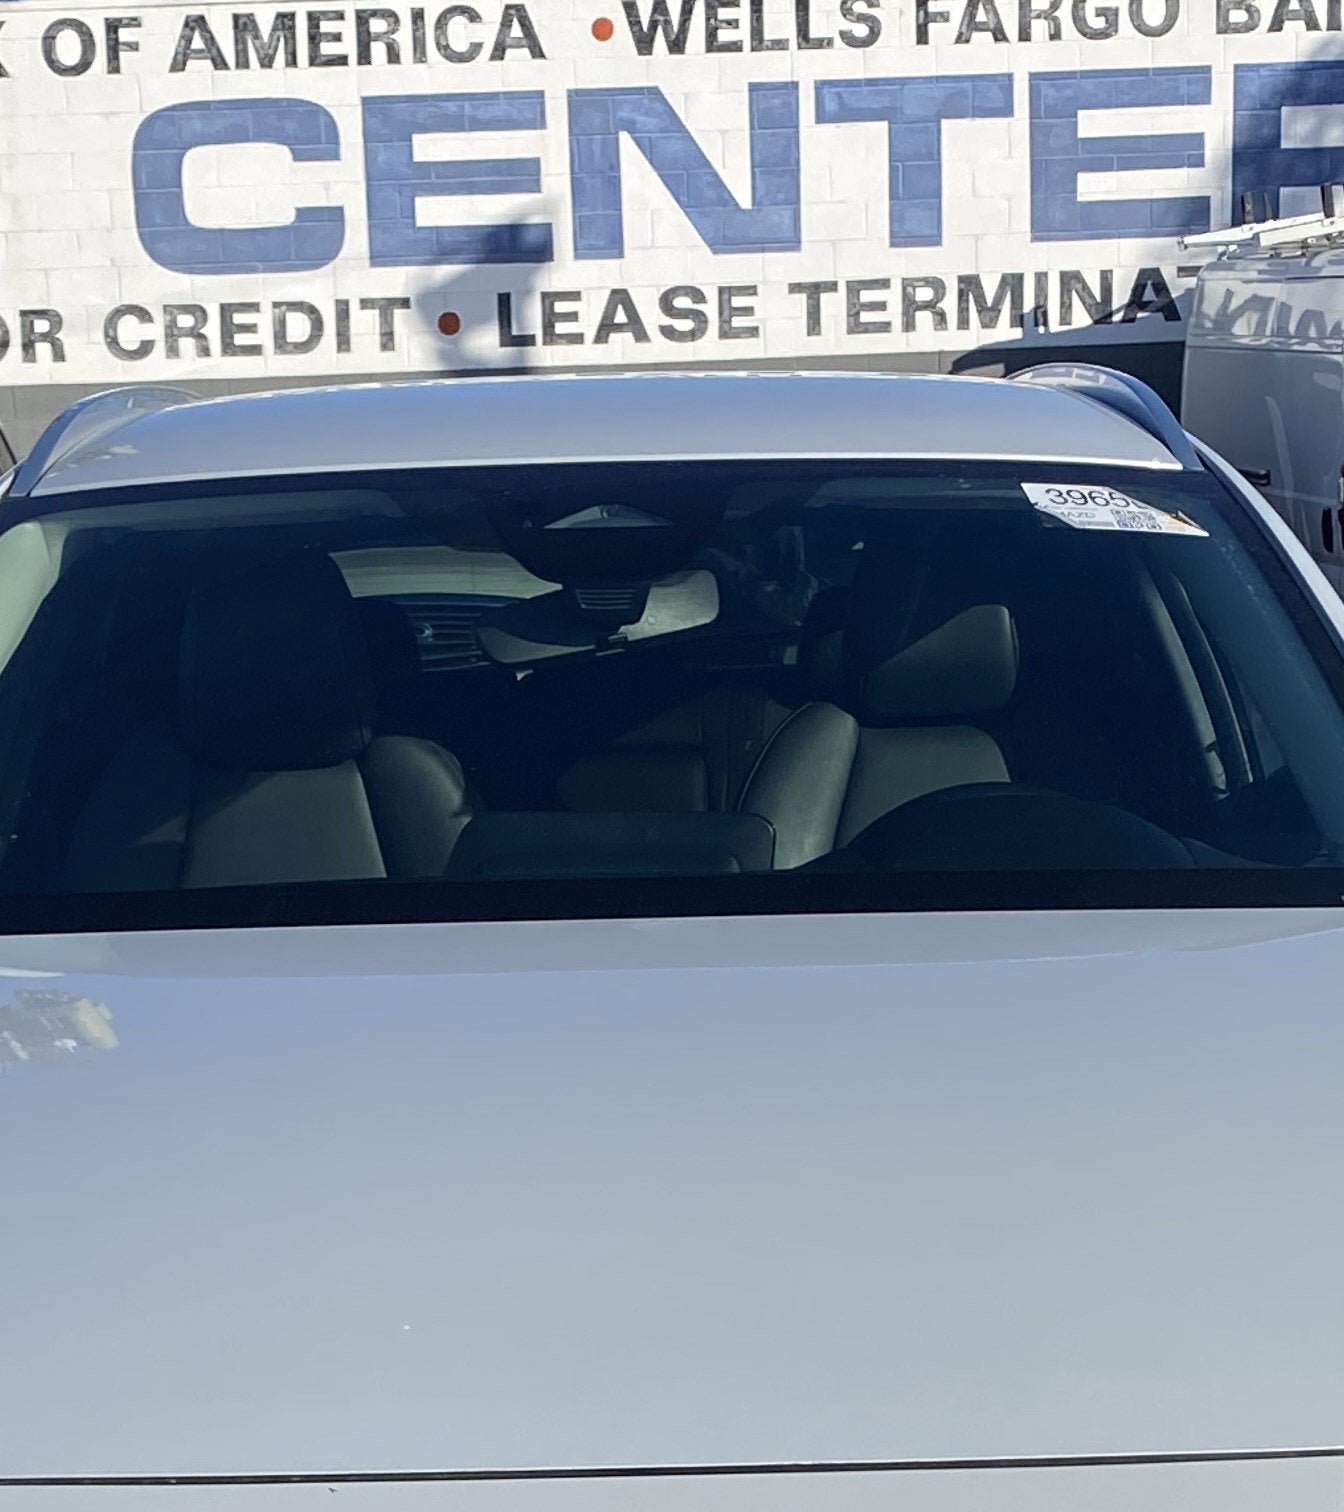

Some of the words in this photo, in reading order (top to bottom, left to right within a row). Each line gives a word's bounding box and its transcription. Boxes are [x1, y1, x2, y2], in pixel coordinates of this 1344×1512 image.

[41, 16, 143, 77] OF
[169, 4, 548, 72] AMERICA
[622, 0, 882, 56] WELLS
[915, 0, 1182, 45] FARGO
[102, 296, 412, 361] CREDIT
[496, 285, 761, 349] LEASE
[789, 264, 1202, 338] TERMINA
